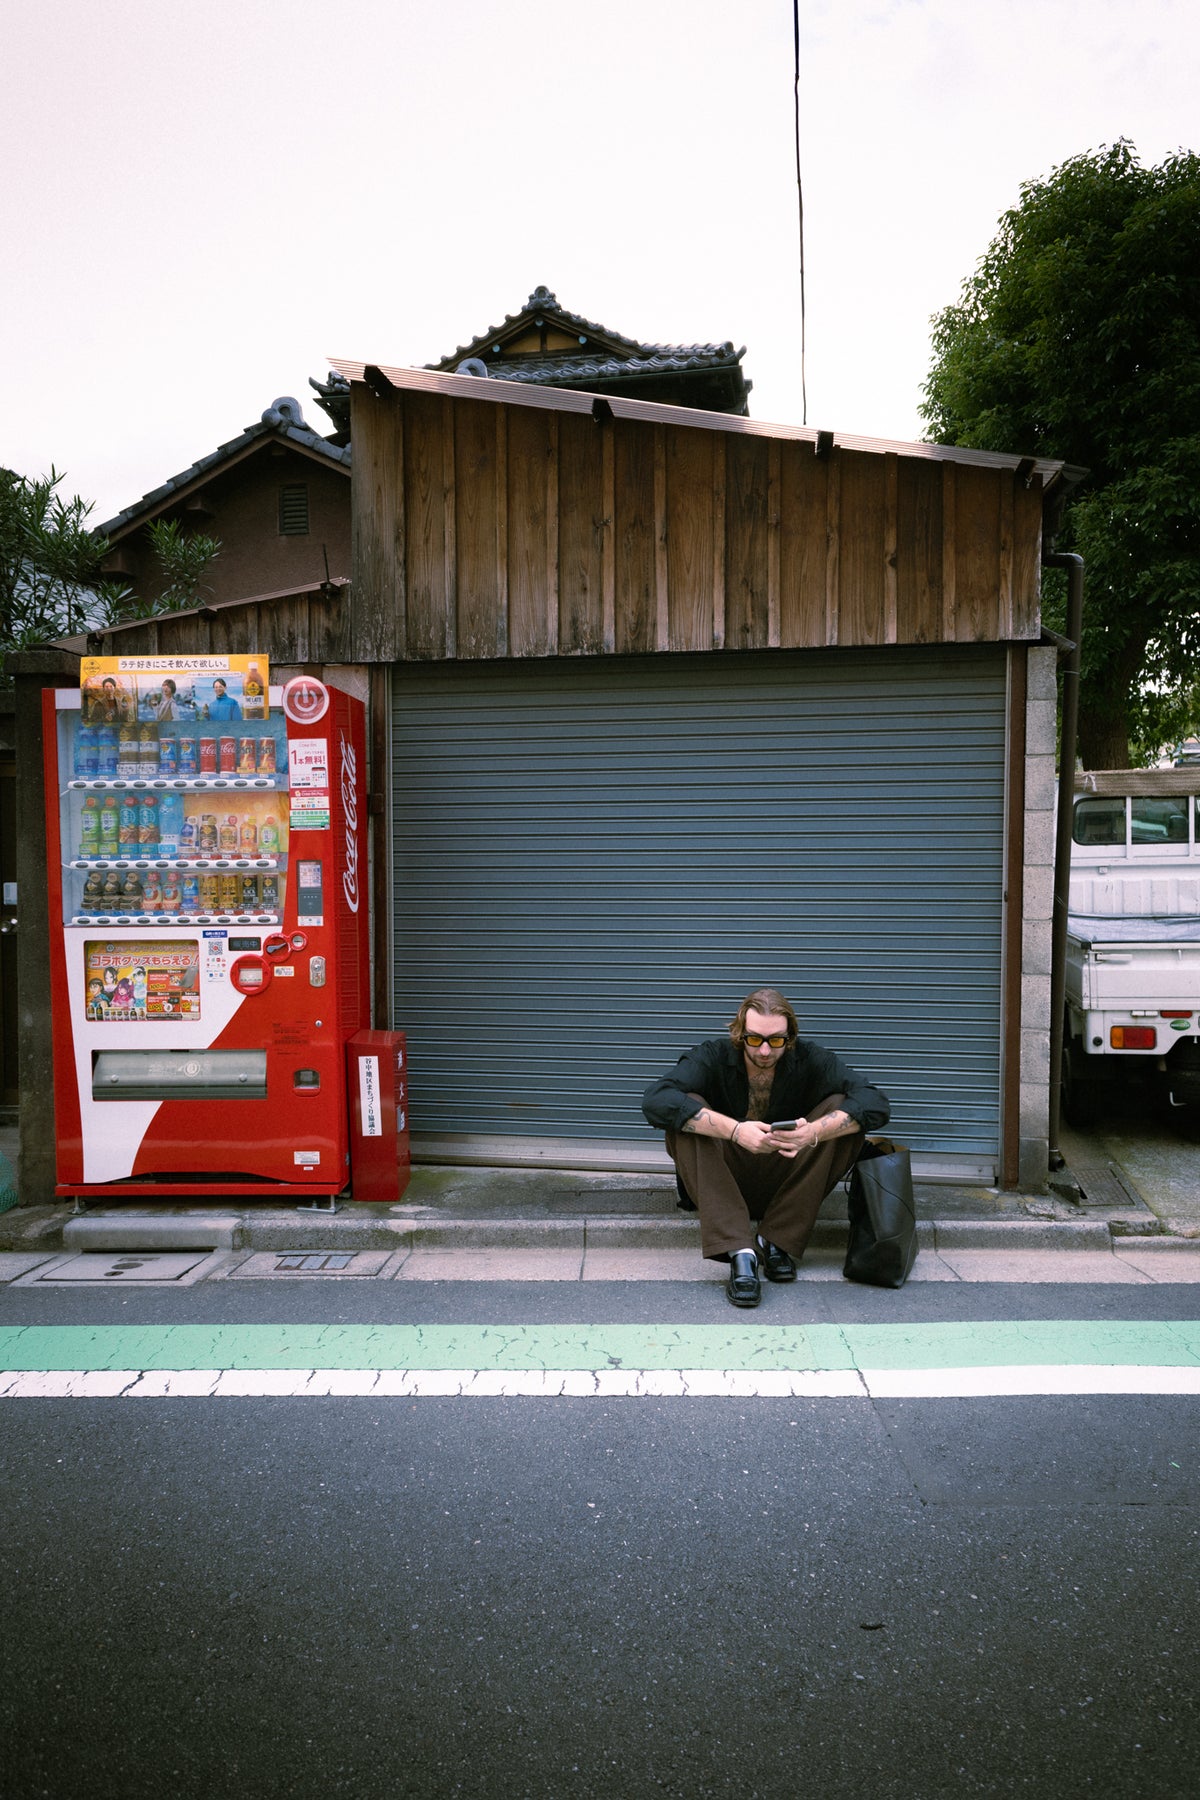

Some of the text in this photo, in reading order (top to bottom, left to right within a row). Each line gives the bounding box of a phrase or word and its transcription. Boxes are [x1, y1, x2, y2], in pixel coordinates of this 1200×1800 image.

[120, 659, 228, 669] ラテ好きにこそ飲んで欲しい。
[340, 728, 359, 913] Coca-Cola
[365, 1057, 376, 1135] 谷中地区まちづくり協議会
